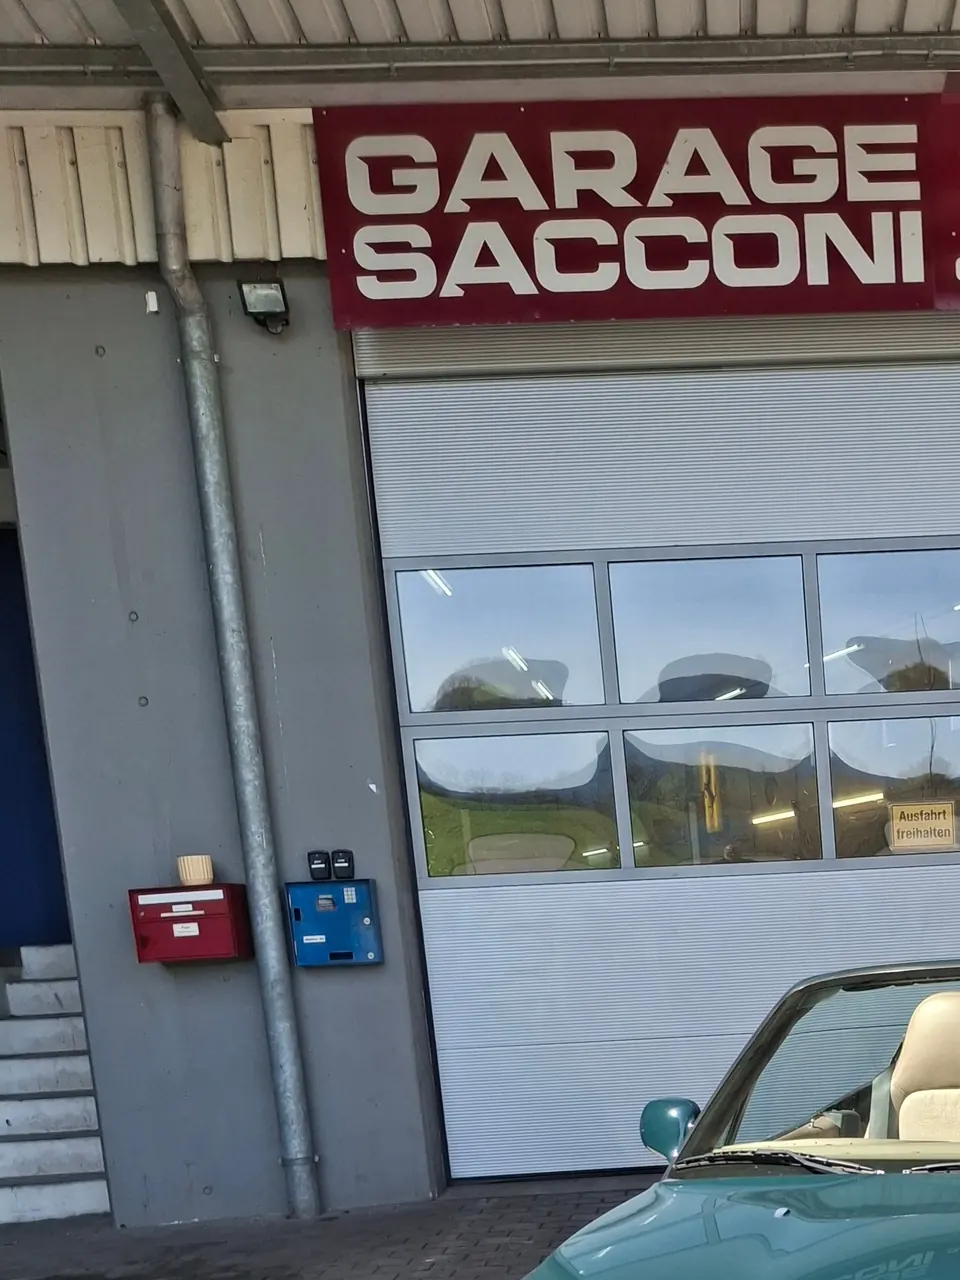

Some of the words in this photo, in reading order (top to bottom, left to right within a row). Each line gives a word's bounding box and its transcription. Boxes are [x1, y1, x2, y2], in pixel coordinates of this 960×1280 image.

[345, 124, 921, 216] GARAGE
[353, 210, 925, 300] SACCONI
[896, 827, 951, 839] freihalten
[899, 809, 947, 822] Ausfahrt
